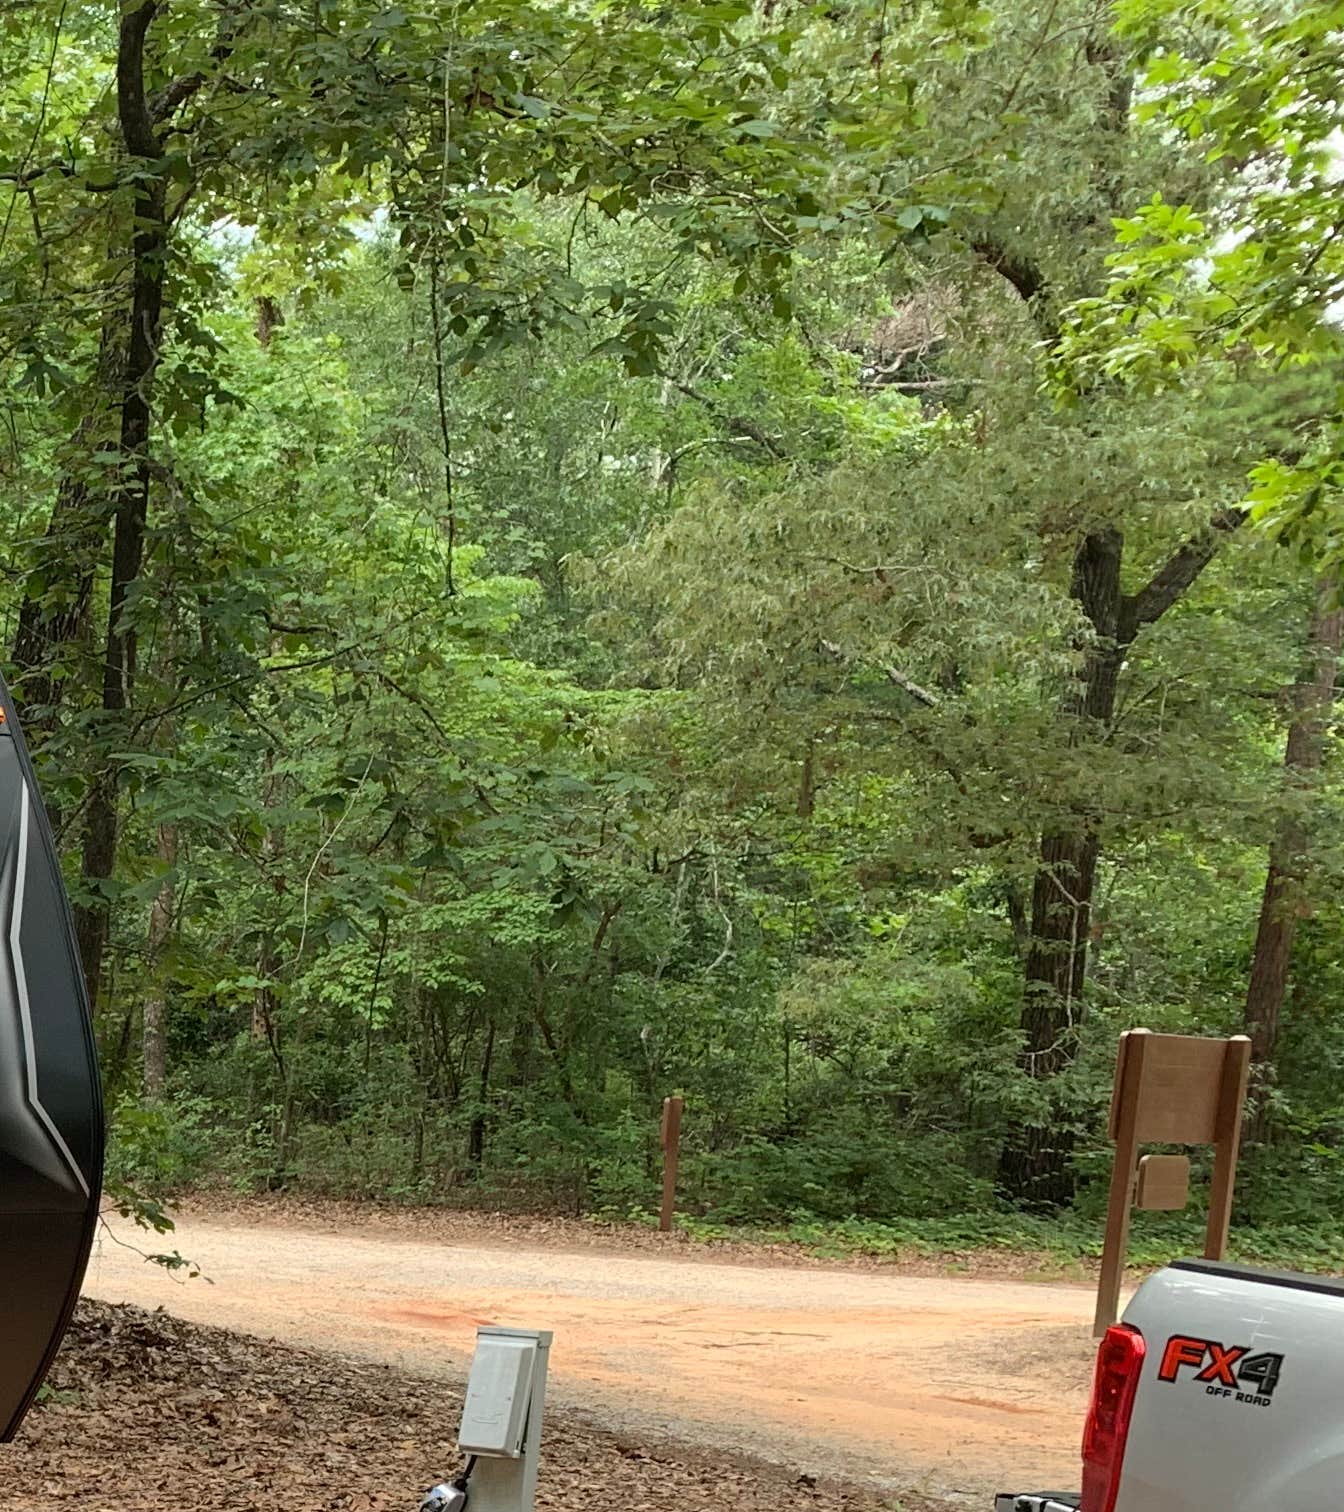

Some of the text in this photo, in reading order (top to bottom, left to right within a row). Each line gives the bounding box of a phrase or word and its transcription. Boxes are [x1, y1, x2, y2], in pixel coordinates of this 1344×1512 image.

[1157, 1334, 1285, 1396] FX4
[1206, 1385, 1271, 1407] OFF ROAD
